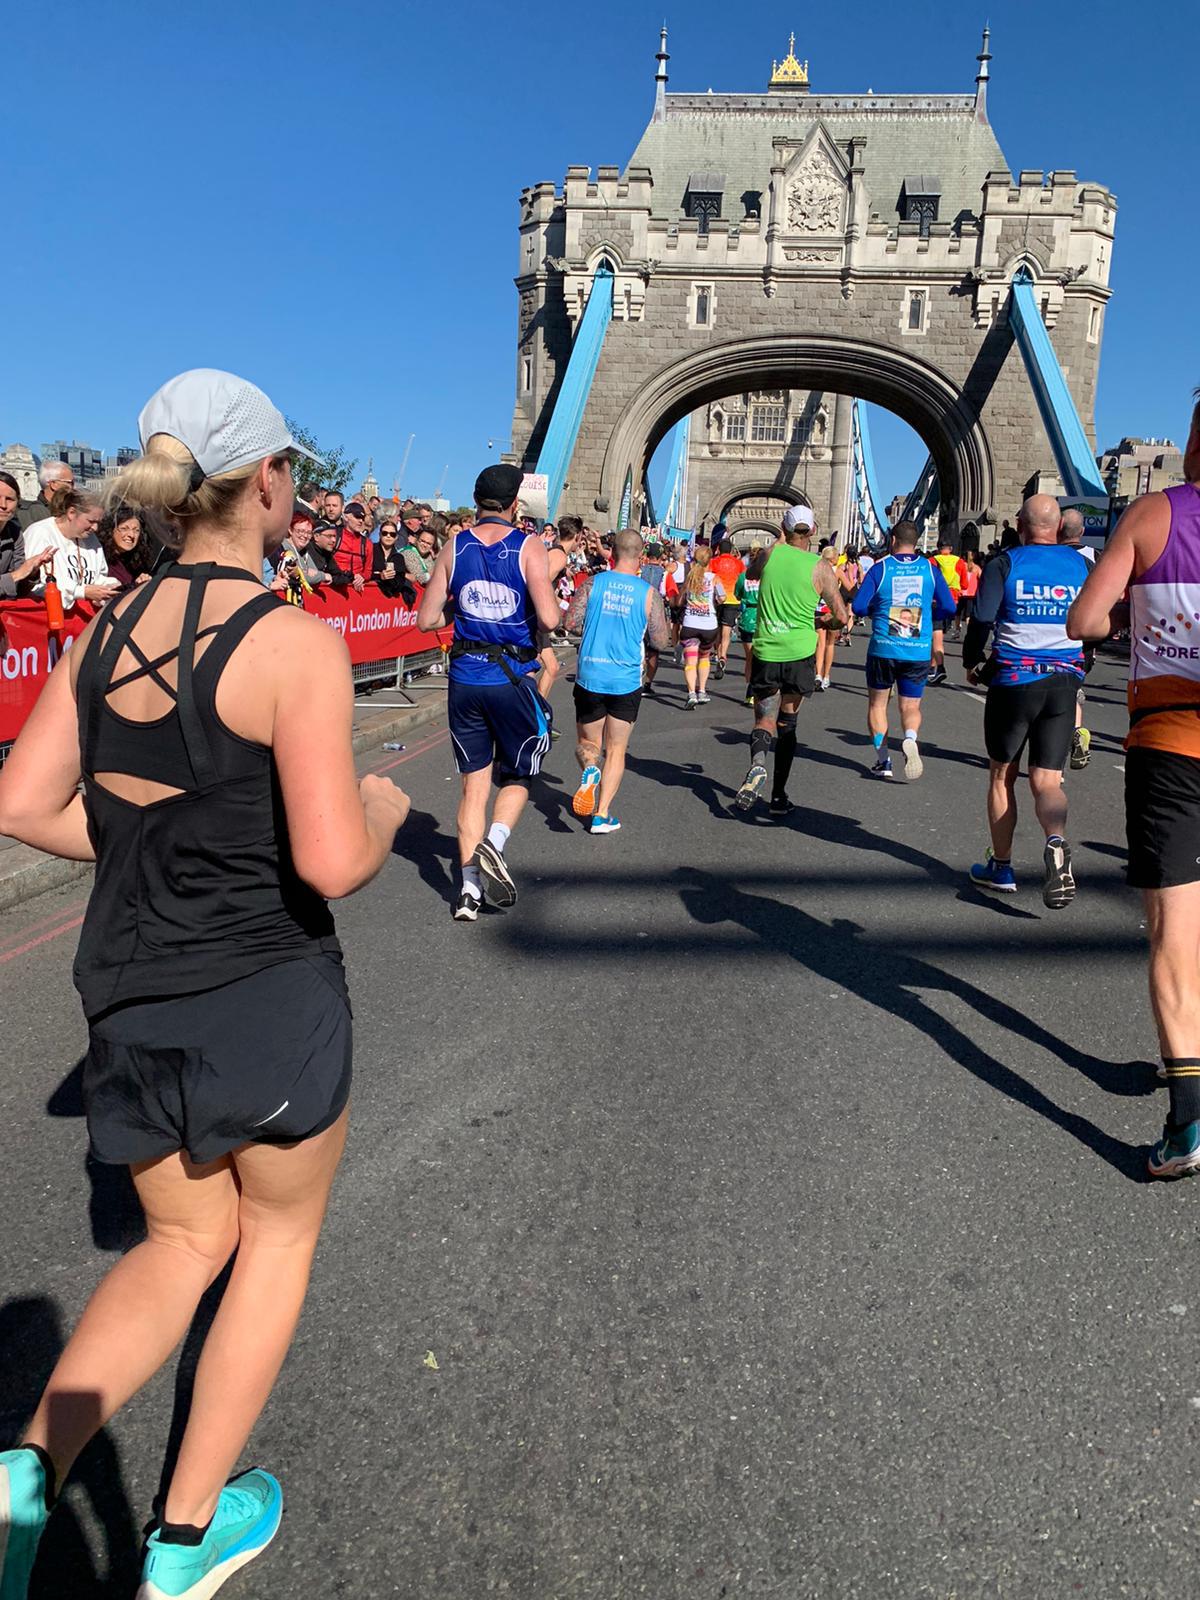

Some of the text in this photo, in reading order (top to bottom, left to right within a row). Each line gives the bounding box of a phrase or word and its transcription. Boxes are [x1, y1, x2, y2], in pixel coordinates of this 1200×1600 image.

[608, 582, 635, 592] LLOYD
[1016, 580, 1082, 600] Lucy
[482, 595, 510, 605] mind
[603, 590, 634, 605] Martin
[907, 598, 922, 607] MS
[603, 601, 630, 614] House
[315, 613, 348, 637] ney
[349, 609, 391, 633] London
[0, 645, 38, 679] on
